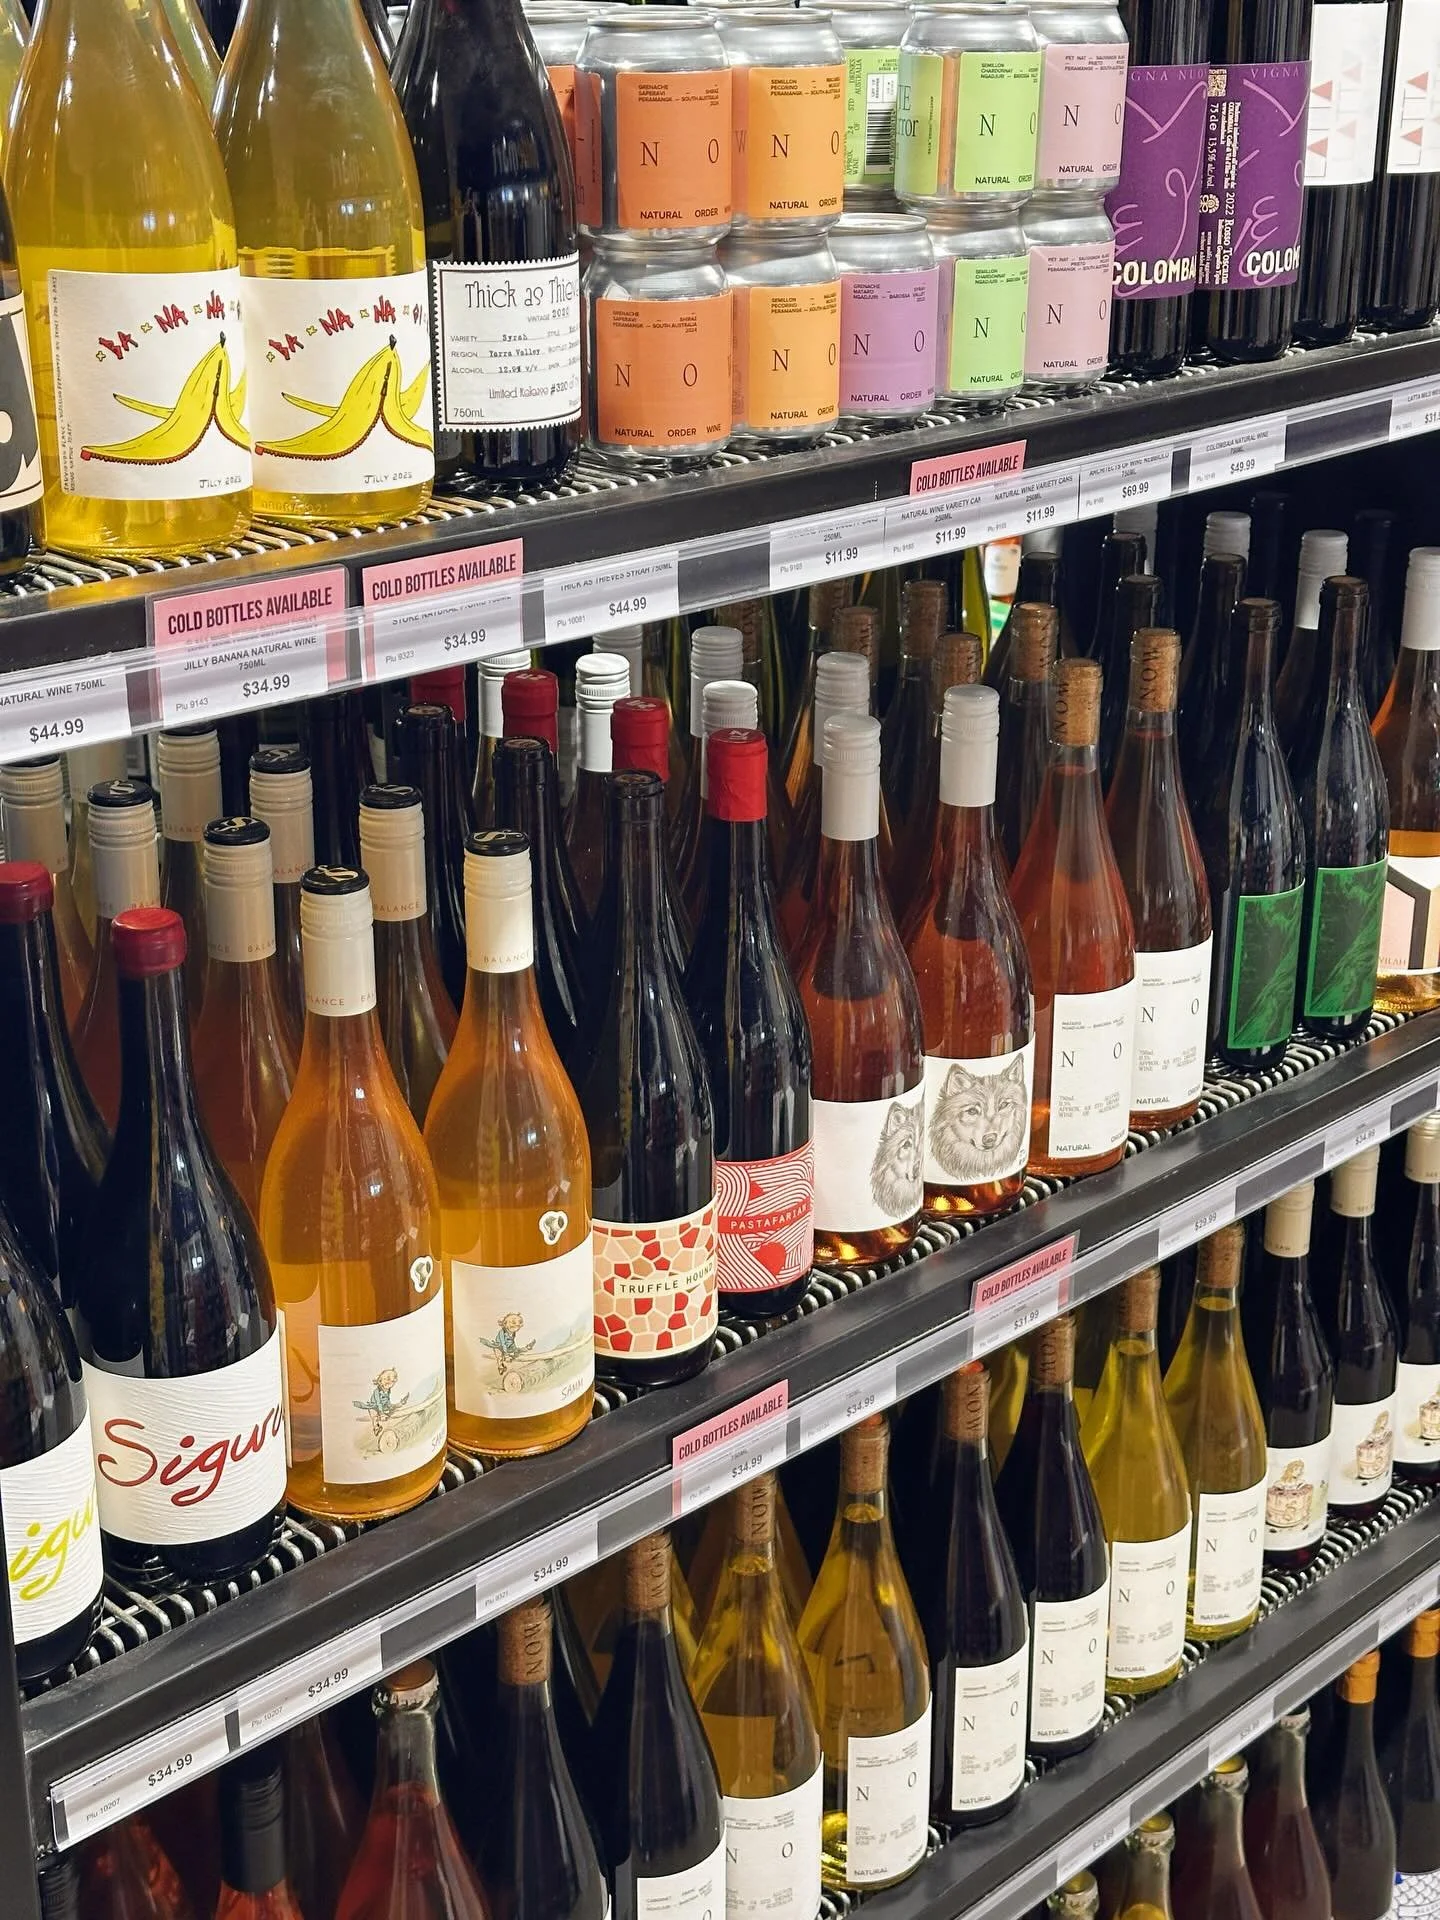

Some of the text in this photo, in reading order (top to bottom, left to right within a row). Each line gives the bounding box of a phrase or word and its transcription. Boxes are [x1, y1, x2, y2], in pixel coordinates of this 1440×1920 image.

[1251, 67, 1299, 78] VIGNA
[1058, 164, 1094, 173] NATURAL
[975, 175, 1011, 185] NATURAL
[640, 207, 719, 220] NATURAL ORDER
[769, 197, 838, 210] NATURAL ORDER
[1224, 192, 1235, 216] 2022
[1222, 219, 1234, 245] Rosso
[1221, 248, 1233, 284] Toscana
[465, 280, 517, 308] Thick
[524, 286, 544, 306] as
[1043, 359, 1078, 368] NATURAL
[970, 374, 1004, 384] NATURAL
[851, 390, 922, 402] NATURAL ORDER
[453, 407, 485, 418] 750mL
[771, 410, 808, 420] NATURAL
[615, 423, 722, 438] NATURAL ORDER WINE
[916, 454, 1019, 492] COLD BOTTLES AVAILABLE
[1230, 458, 1256, 475] $49.99
[1122, 481, 1149, 499] $69.99
[1026, 505, 1055, 524] $11.99
[935, 525, 966, 545] $11.99
[825, 546, 858, 565] $11.99
[372, 553, 517, 601] COLD BOTTLES AVAILABLE
[167, 610, 203, 636] COLD
[206, 599, 263, 629] BOTTLES
[266, 586, 333, 617] AVAILABLE
[609, 596, 647, 617] $44.99
[443, 628, 487, 651] $34.99
[184, 636, 317, 671] JILLY BANANA NATURAL WINE
[238, 658, 266, 671] 750ML
[46, 684, 73, 697] WINE
[75, 678, 106, 692] 750ML
[242, 673, 291, 698] $34.99
[189, 697, 209, 709] 9143
[29, 718, 85, 744] $44.99
[1056, 1143, 1092, 1152] NATURAL
[620, 1263, 713, 1294] TRUFFLE HOUND
[981, 1249, 1068, 1302] COLD BOTTLES AVAILABLE
[1014, 1309, 1040, 1330] $31.99
[846, 1394, 875, 1417] $34.99
[679, 1394, 783, 1460] COLD BOTTLES AVAILABLE
[731, 1454, 763, 1478] $34.99
[532, 1556, 569, 1583] $34.99
[307, 1668, 349, 1698] $34.99
[147, 1753, 193, 1787] $34.99
